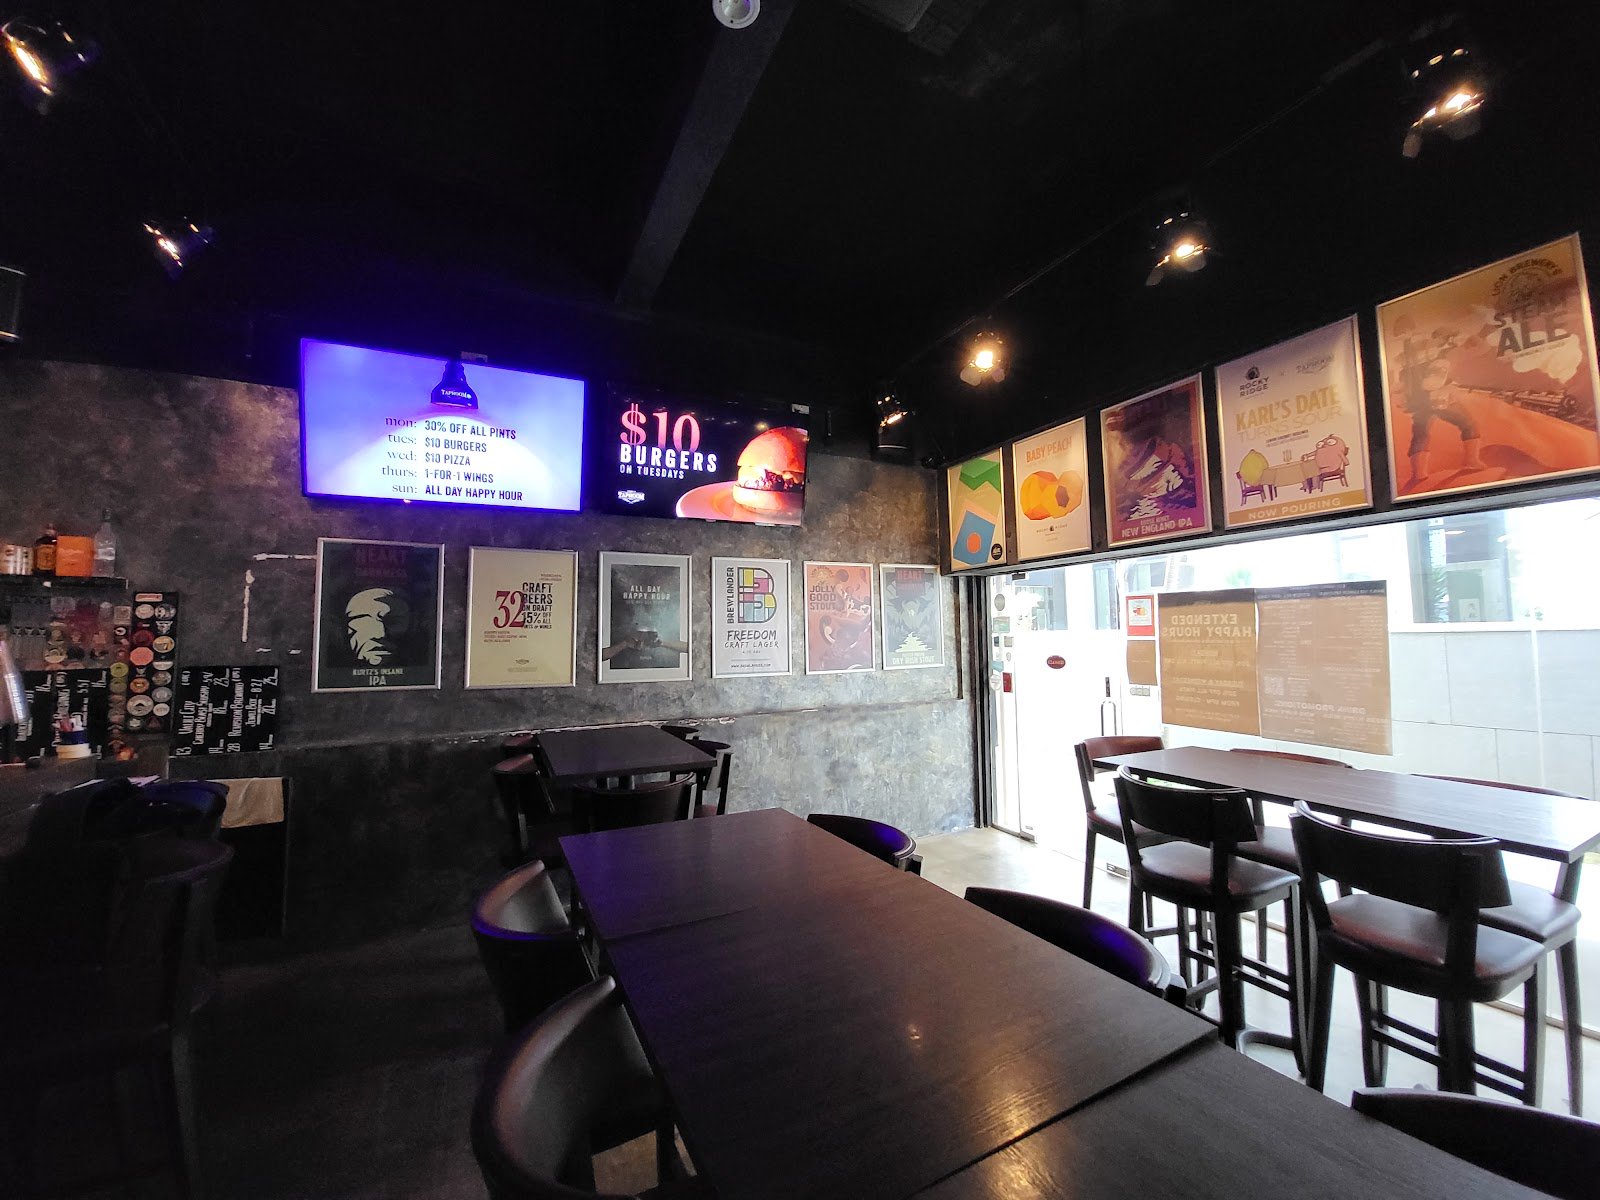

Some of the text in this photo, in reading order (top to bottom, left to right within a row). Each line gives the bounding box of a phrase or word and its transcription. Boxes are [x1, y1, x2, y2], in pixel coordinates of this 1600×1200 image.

[1497, 309, 1571, 358] ALE
[1239, 376, 1269, 392] ROCKY
[1239, 384, 1269, 397] RIDGE
[1235, 384, 1341, 432] KARL'S DATE
[385, 416, 517, 440] mon: 30% OFF ALL PINTS
[620, 403, 700, 452] $10
[1237, 419, 1290, 443] TURNS
[1292, 405, 1344, 430] SOUR
[388, 433, 487, 453] tues: $10 BURGERS
[1026, 445, 1046, 462] BABY
[1047, 436, 1073, 456] PEACH
[387, 450, 471, 466] wed: $10 PIZZA
[620, 443, 717, 473] BURGERS
[382, 465, 494, 483] thurs: 1-FOR-1 WINGS
[620, 464, 684, 479] ON TUESDAYS
[392, 484, 523, 501] sun: ALL DAY HAPPY HOUR
[1248, 497, 1342, 520] NOW POURING
[1122, 516, 1193, 538] NEW ENGLAND IPA
[522, 582, 553, 593] CRAFT
[810, 593, 836, 601] GOOD
[493, 590, 525, 628] 32
[810, 602, 836, 610] STOUT
[521, 612, 542, 624] 15%
[727, 630, 777, 641] FREEDOM
[724, 641, 749, 649] CRAFT
[369, 676, 387, 686] IPA
[227, 743, 240, 752] 28
